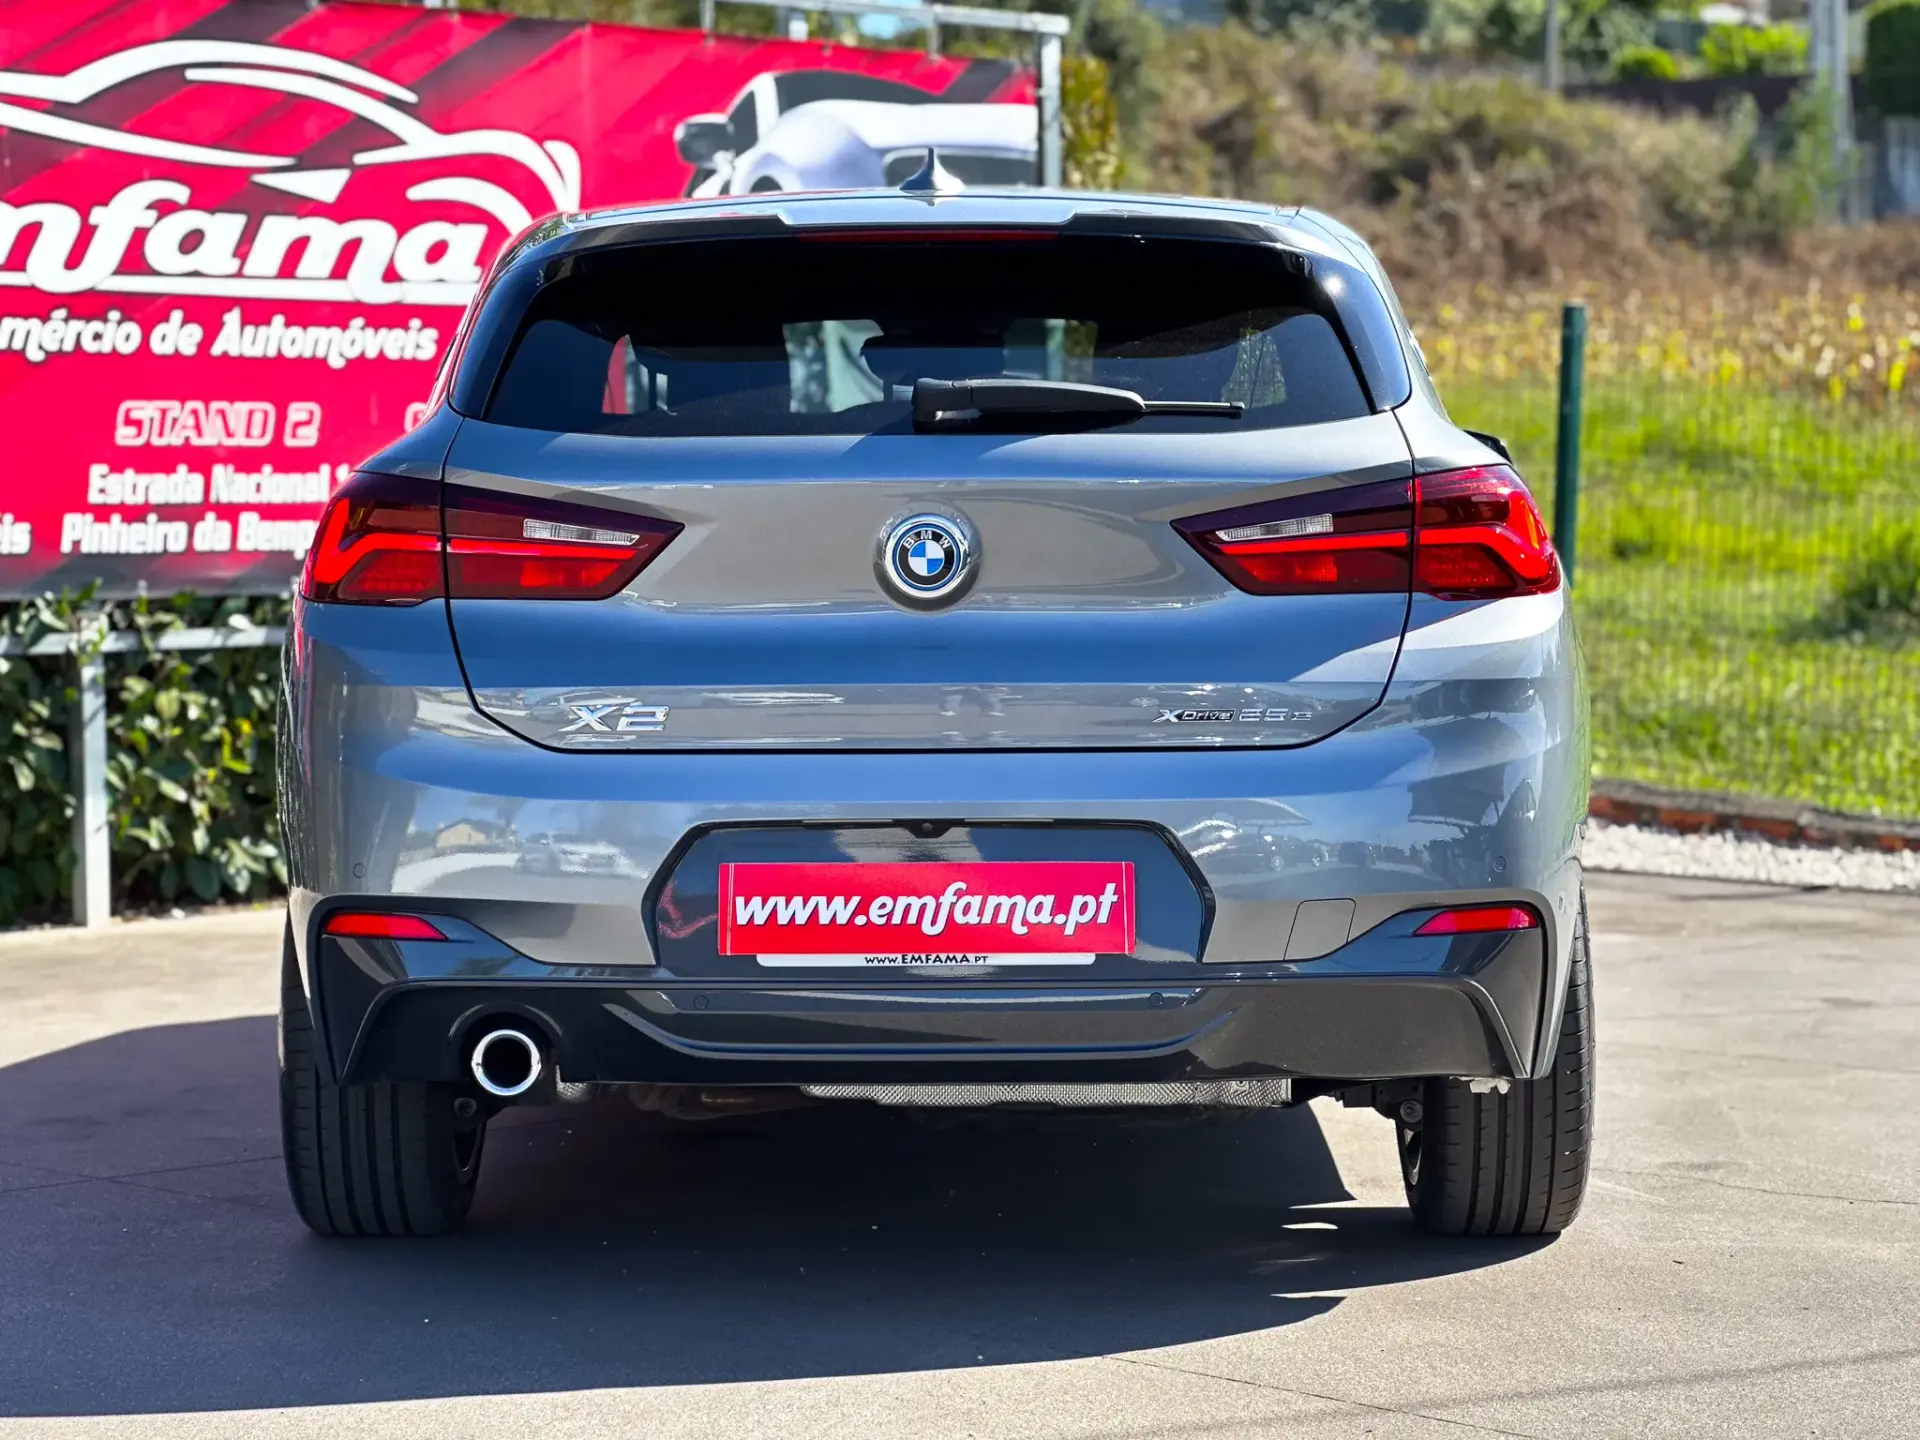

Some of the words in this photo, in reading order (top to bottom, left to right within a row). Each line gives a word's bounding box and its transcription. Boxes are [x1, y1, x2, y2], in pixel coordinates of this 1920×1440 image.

[150, 309, 204, 356] de
[210, 305, 439, 369] Automóveis
[115, 400, 275, 447] STAND
[283, 401, 321, 447] 2
[88, 463, 204, 504] Estrada
[210, 463, 331, 504] Nacional
[60, 512, 188, 553] Pinheiro
[194, 512, 231, 552] da
[903, 530, 951, 549] BMW
[558, 705, 670, 732] X2
[735, 881, 1119, 936] www.emfama.pt
